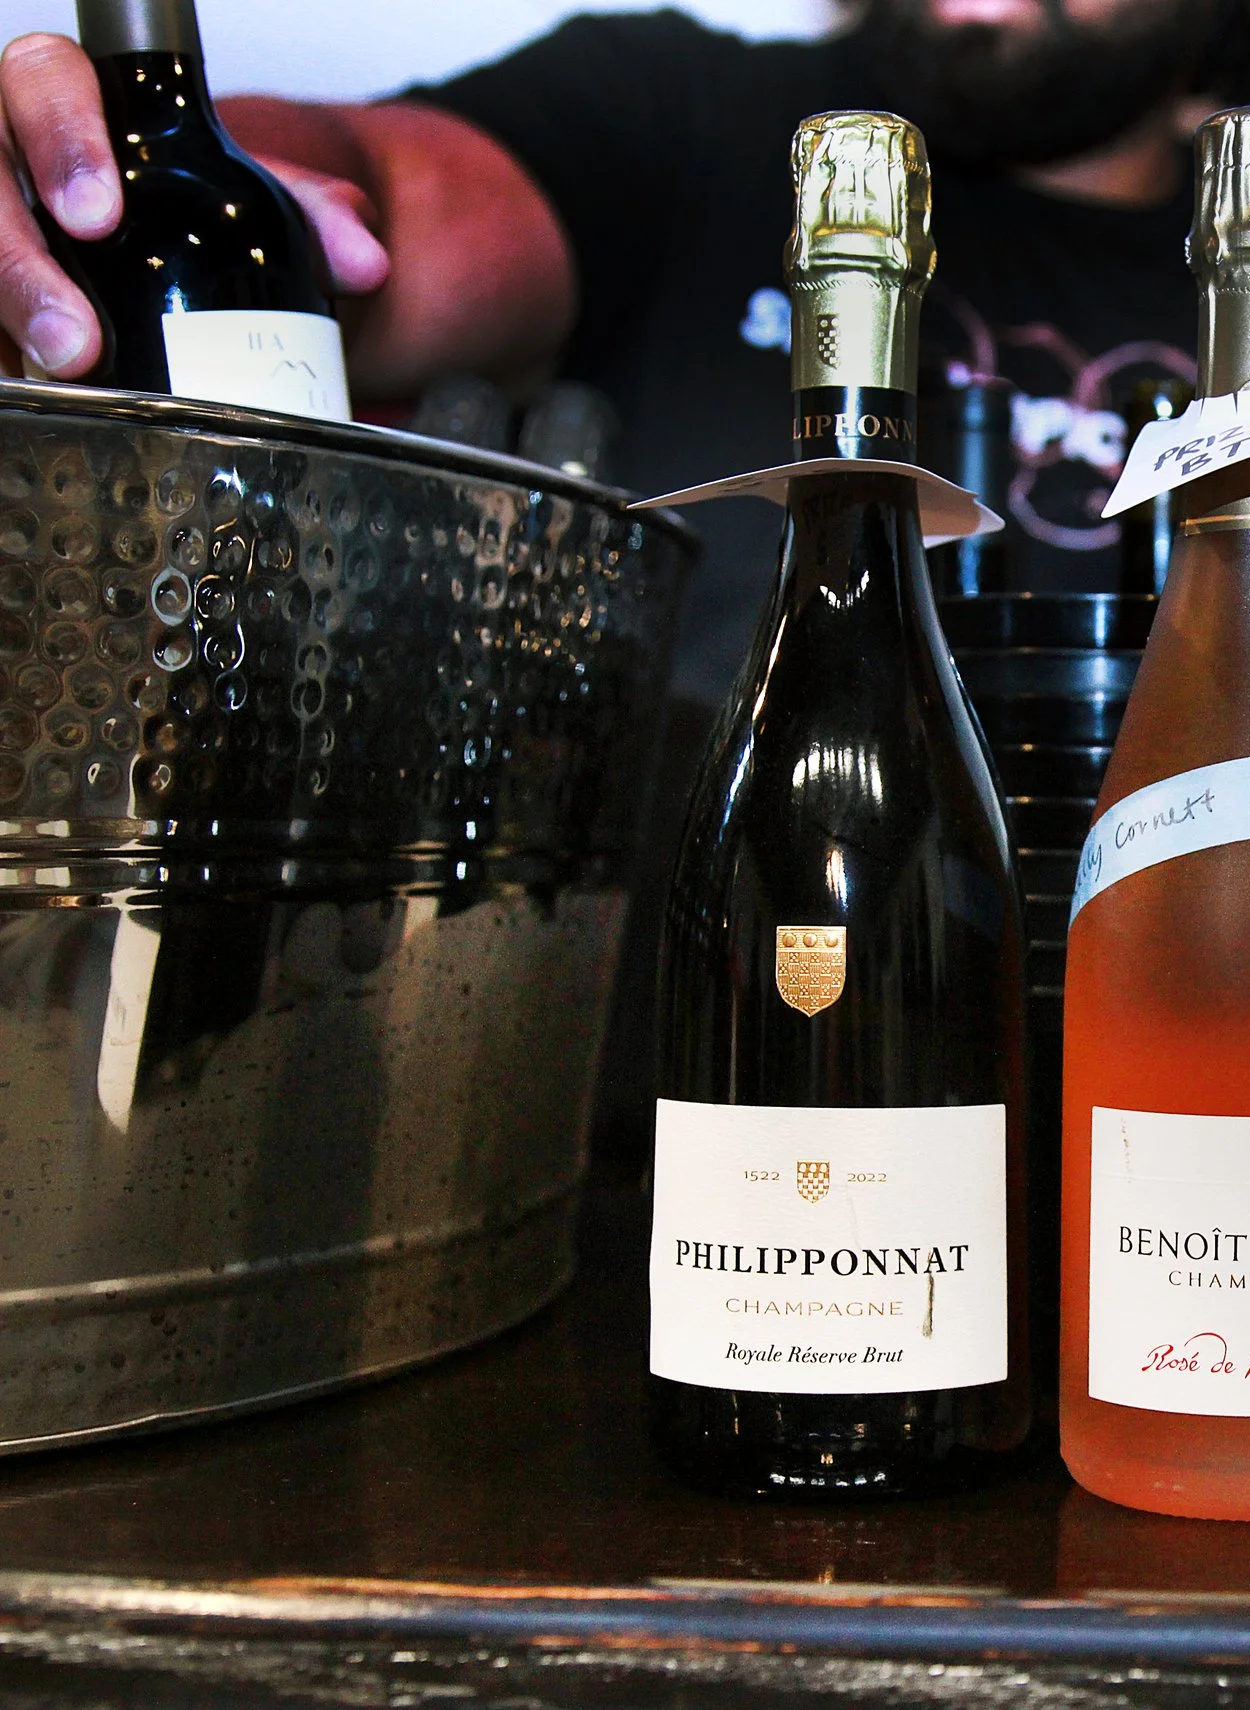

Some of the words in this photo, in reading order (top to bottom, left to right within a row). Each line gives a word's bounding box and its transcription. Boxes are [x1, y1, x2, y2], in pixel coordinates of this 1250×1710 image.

[744, 1170, 781, 1182] 1522
[847, 1173, 888, 1184] 2022
[675, 1239, 970, 1277] PHILIPPONNAT
[1118, 1226, 1248, 1263] BENOÎT
[725, 1298, 905, 1317] CHAMPAGNE
[724, 1342, 783, 1366] Royale
[787, 1346, 858, 1364] Réserve
[861, 1346, 905, 1364] Brut
[1141, 1344, 1200, 1373] Rosé
[1183, 1332, 1236, 1374] de
